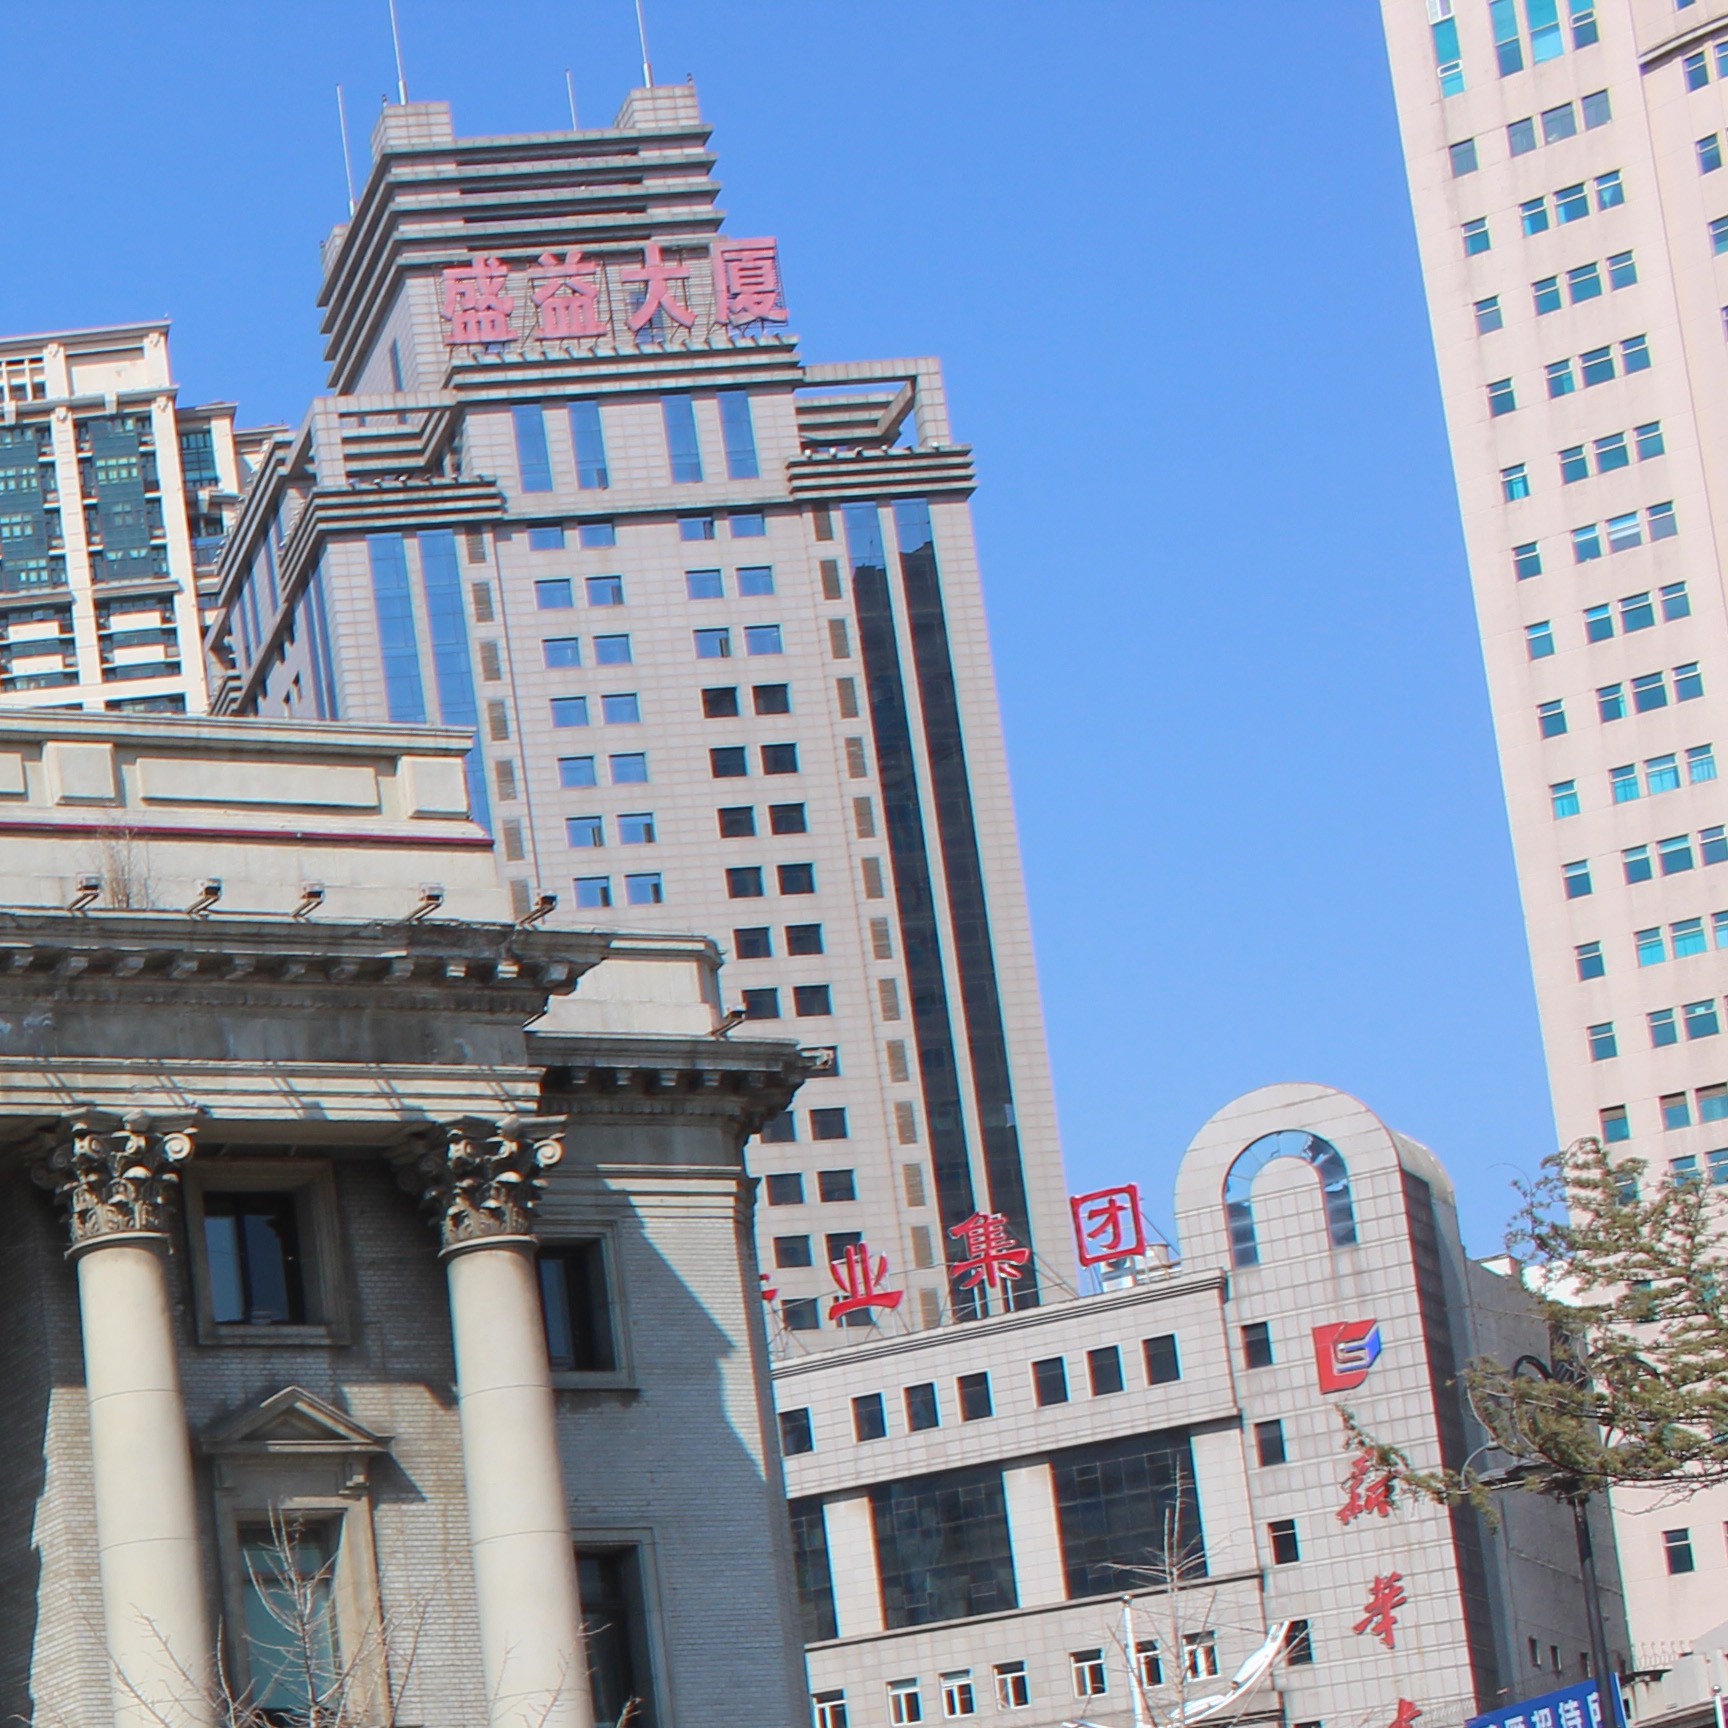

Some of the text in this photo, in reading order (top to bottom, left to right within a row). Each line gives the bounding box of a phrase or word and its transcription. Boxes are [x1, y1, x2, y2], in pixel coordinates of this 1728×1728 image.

[442, 236, 789, 346] 盛益大厦
[761, 1181, 1148, 1321] 业集团
